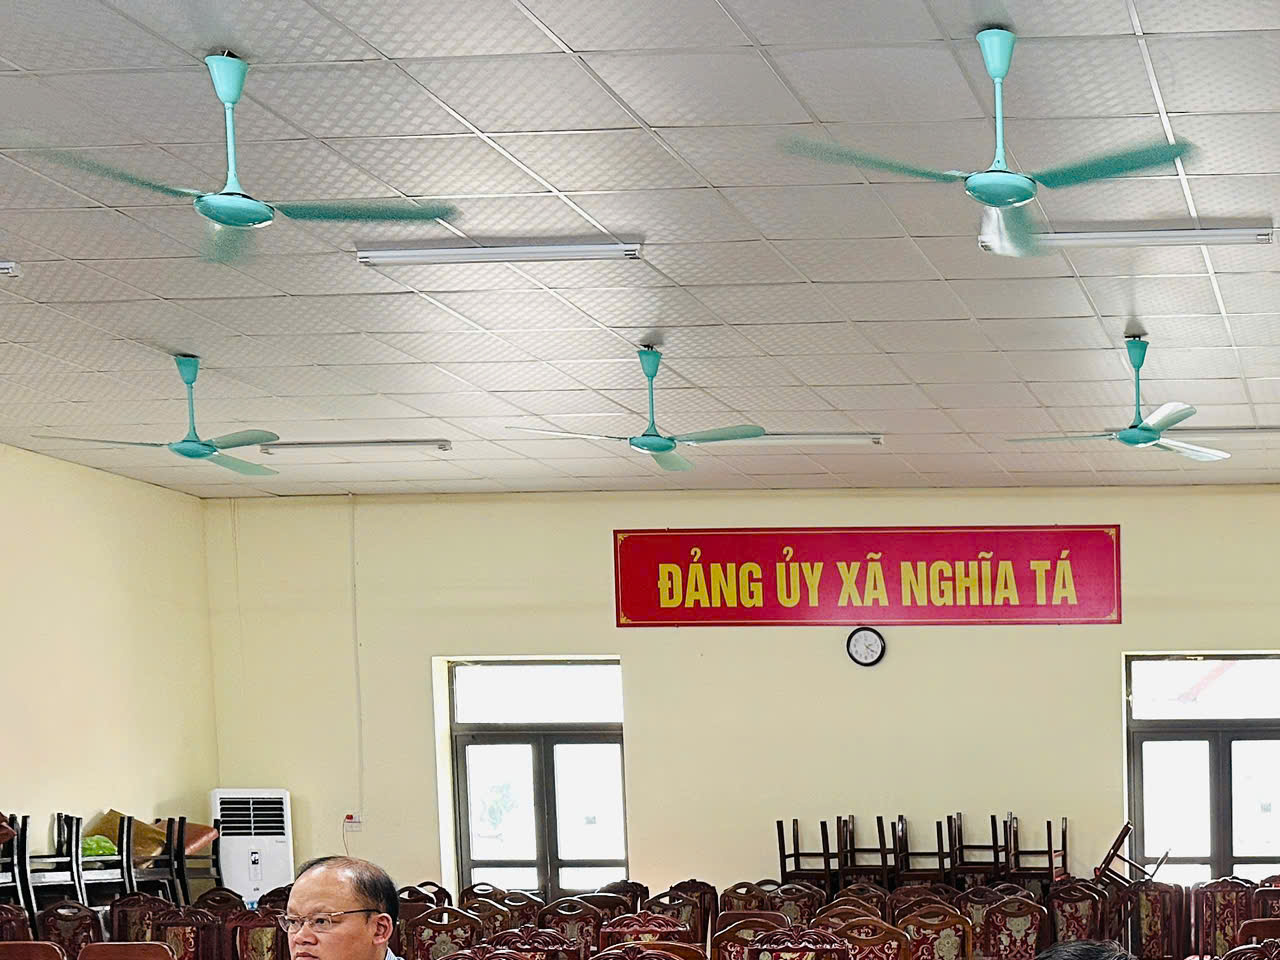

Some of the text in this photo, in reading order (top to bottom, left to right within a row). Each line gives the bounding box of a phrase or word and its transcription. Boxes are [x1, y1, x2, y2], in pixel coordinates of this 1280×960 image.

[658, 545, 1078, 608] ĐẢNG ỦY XÃ NGHĨA TÁ
